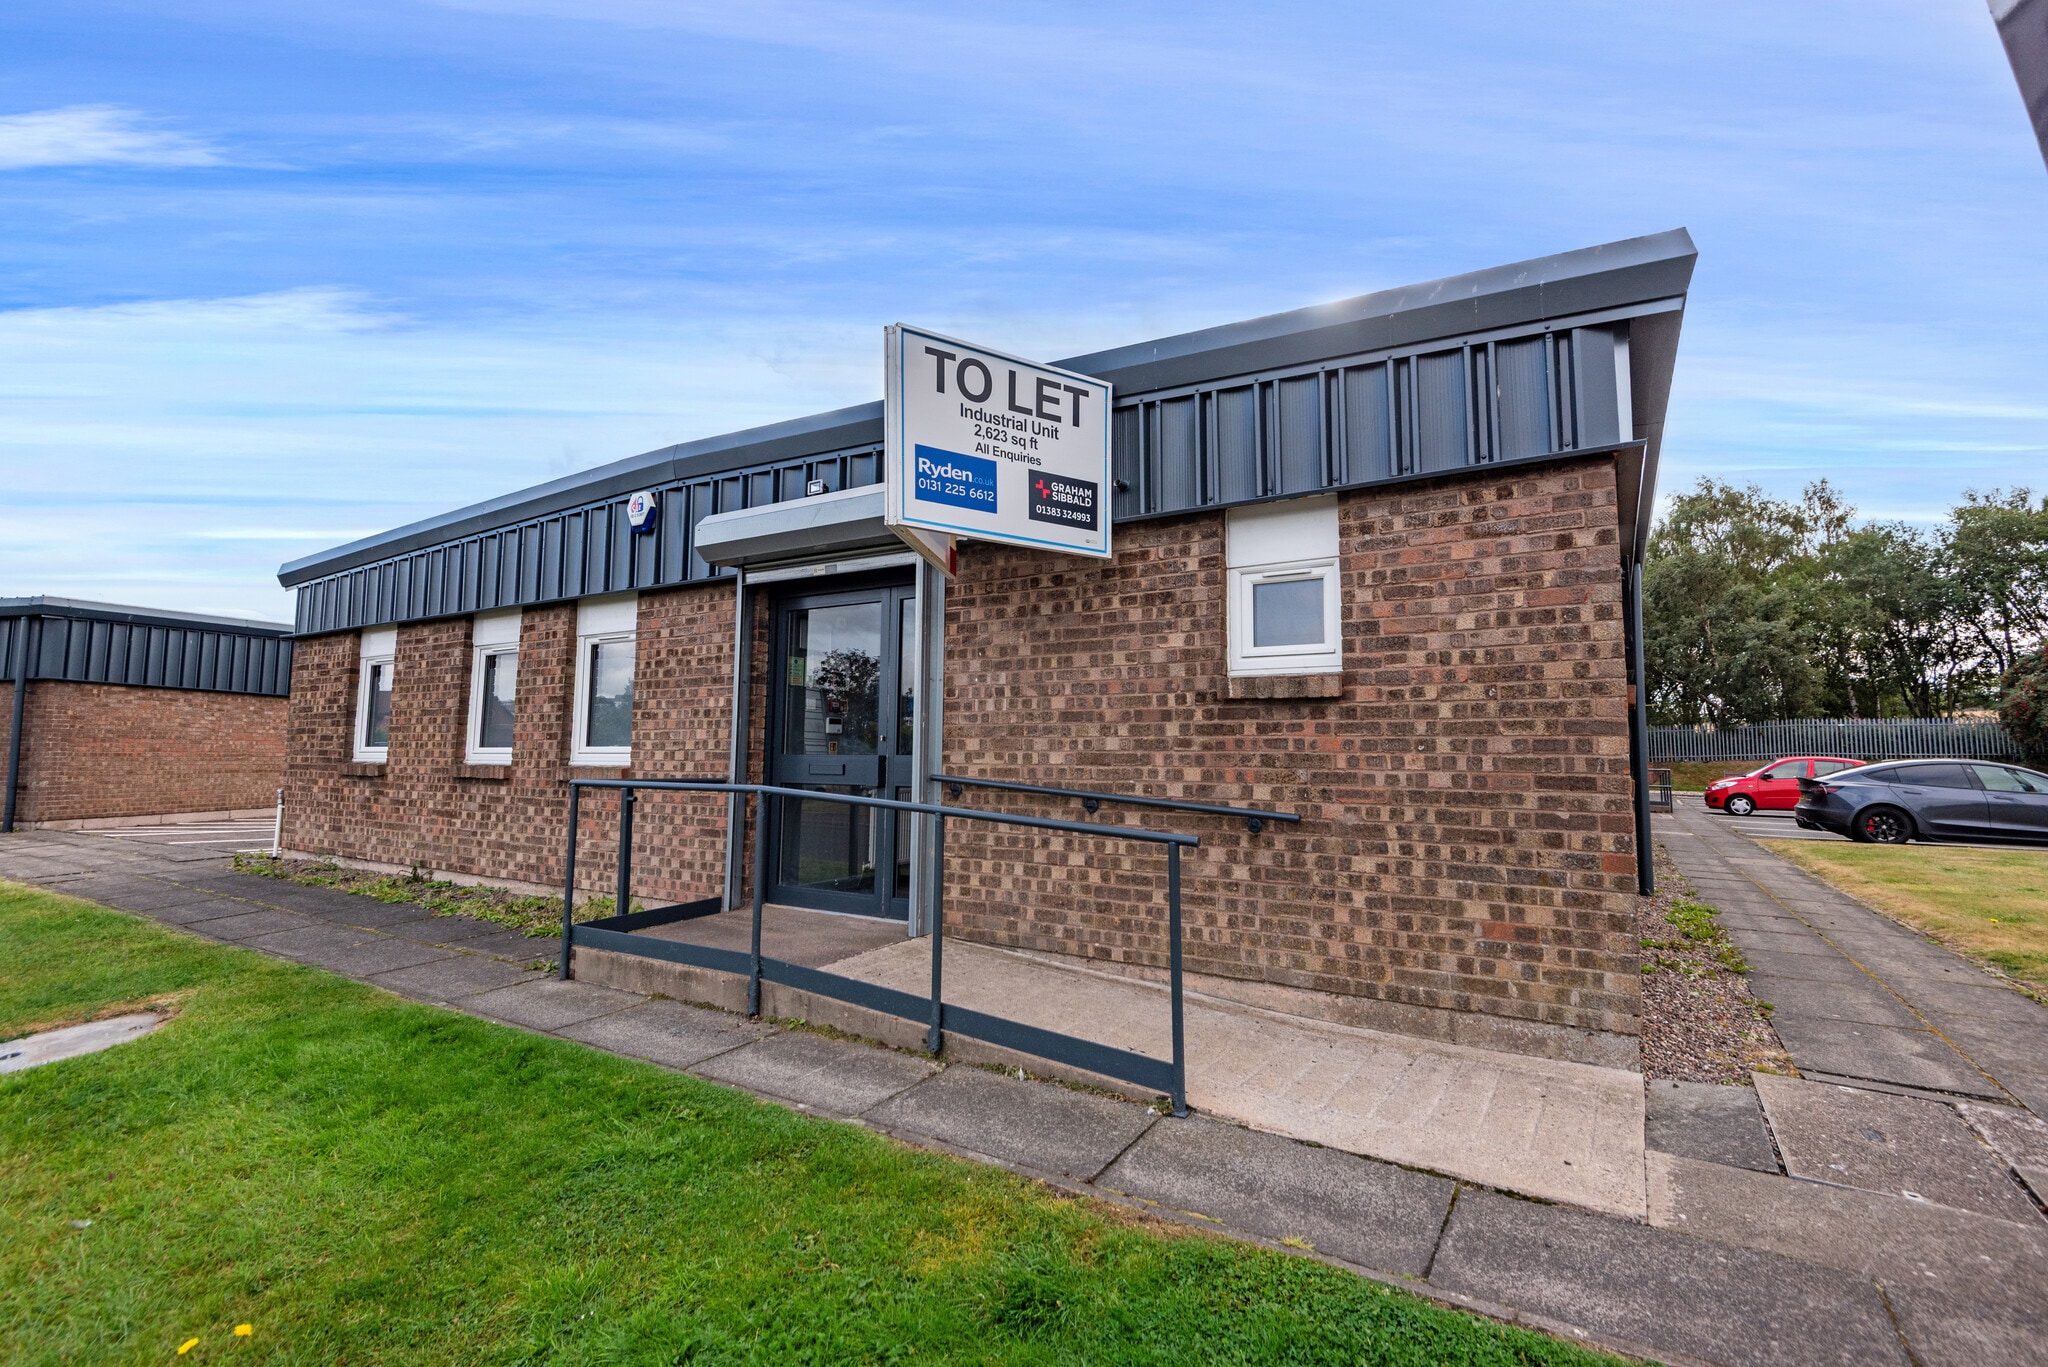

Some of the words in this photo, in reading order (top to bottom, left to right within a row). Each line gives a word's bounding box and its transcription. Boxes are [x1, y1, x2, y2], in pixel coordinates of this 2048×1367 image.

[924, 345, 993, 403] TO
[1008, 369, 1090, 428] LET
[960, 403, 1027, 432] Industrial
[1031, 420, 1060, 441] Unit
[974, 424, 1008, 443] 2,623
[1011, 435, 1026, 451] sq
[1029, 437, 1039, 450] ft
[975, 442, 990, 455] All
[992, 446, 1042, 466] Enquiries
[918, 478, 941, 492] 0131
[945, 483, 966, 496] 225
[969, 487, 995, 502] 6612
[1051, 482, 1092, 498] GRAHAM
[1052, 491, 1092, 507] SIBBALD
[1036, 505, 1061, 518] 01383
[1062, 509, 1091, 523] 324993
